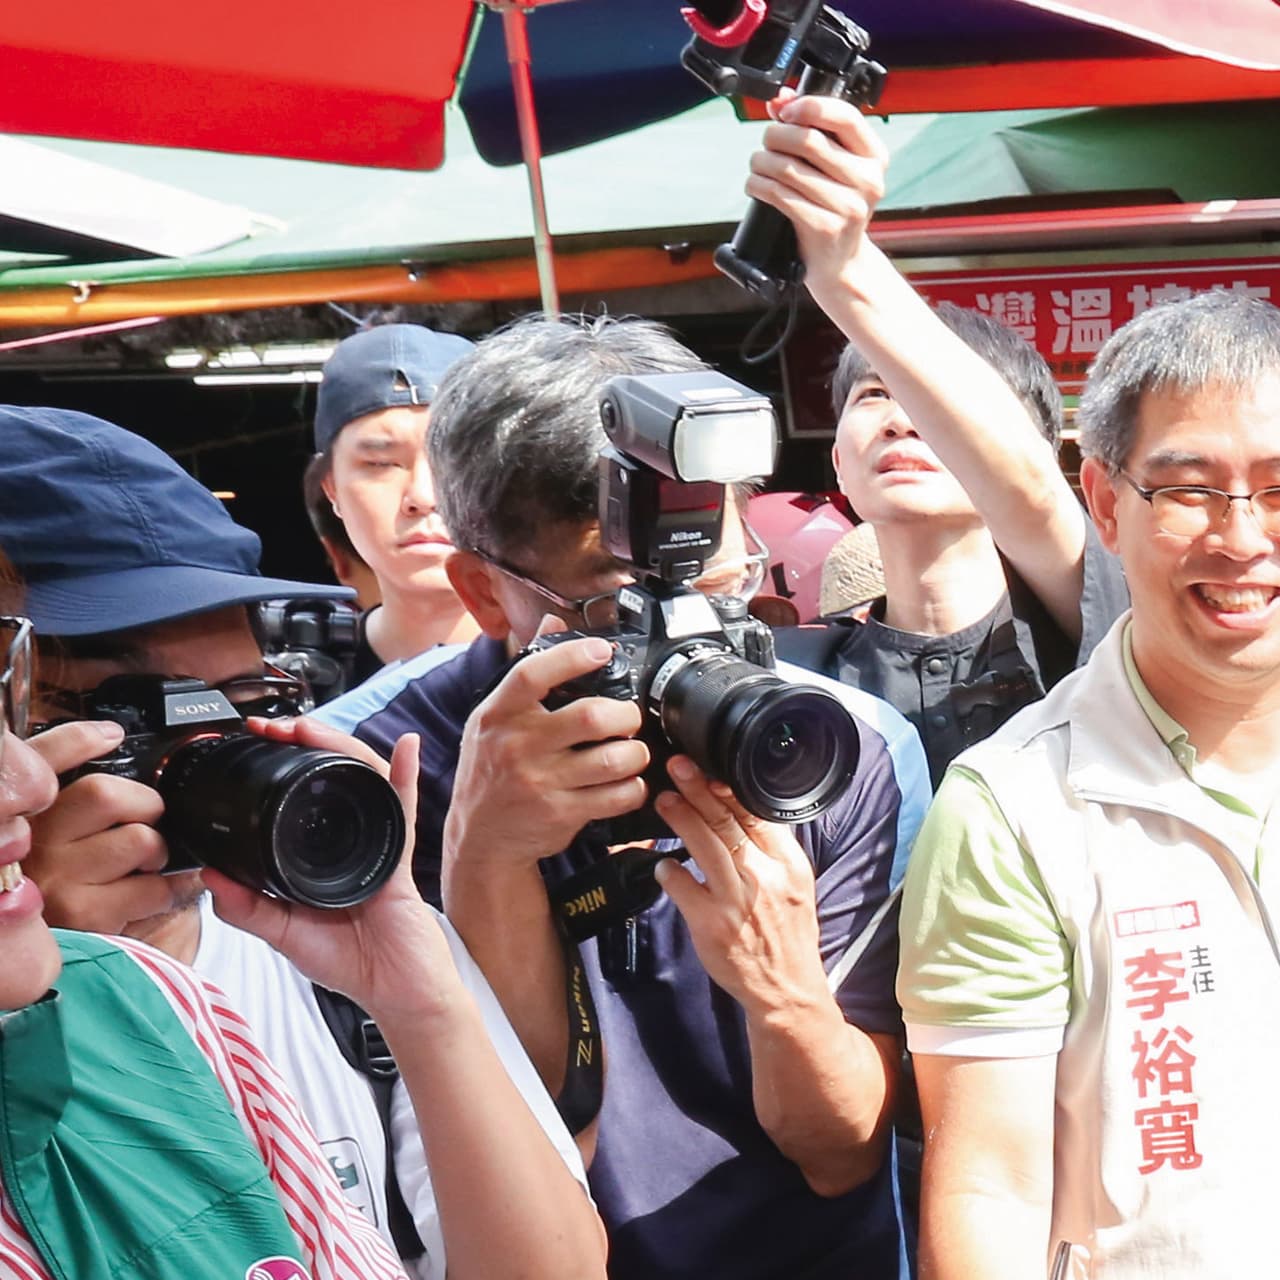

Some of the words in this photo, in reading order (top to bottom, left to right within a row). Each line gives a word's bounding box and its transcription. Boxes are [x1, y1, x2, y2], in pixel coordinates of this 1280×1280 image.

[174, 701, 221, 717] SONY
[1189, 945, 1215, 995] 主任
[1122, 947, 1204, 1176] 李裕寬
